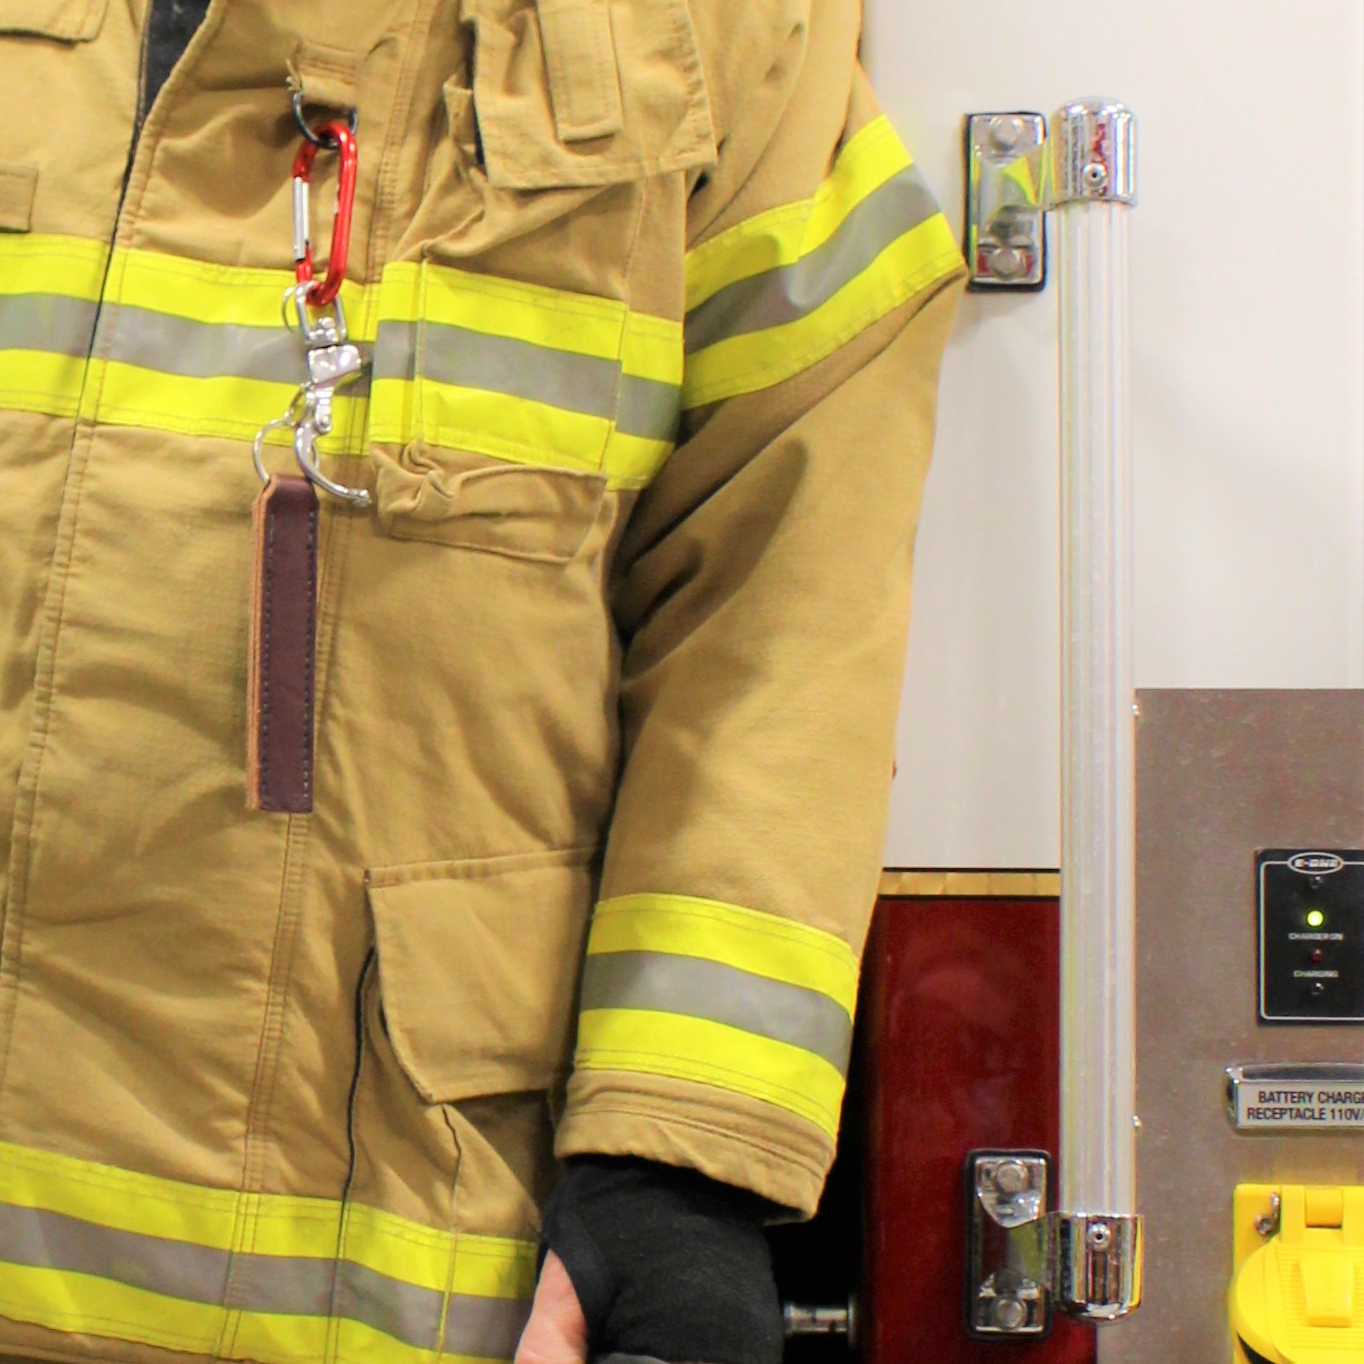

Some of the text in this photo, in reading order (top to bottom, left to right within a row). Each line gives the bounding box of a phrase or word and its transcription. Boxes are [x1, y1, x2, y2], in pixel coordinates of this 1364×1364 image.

[1292, 970, 1339, 978] CHARGING
[1258, 1091, 1313, 1104] BATTERY
[1247, 1108, 1326, 1120] RECEPTACLE
